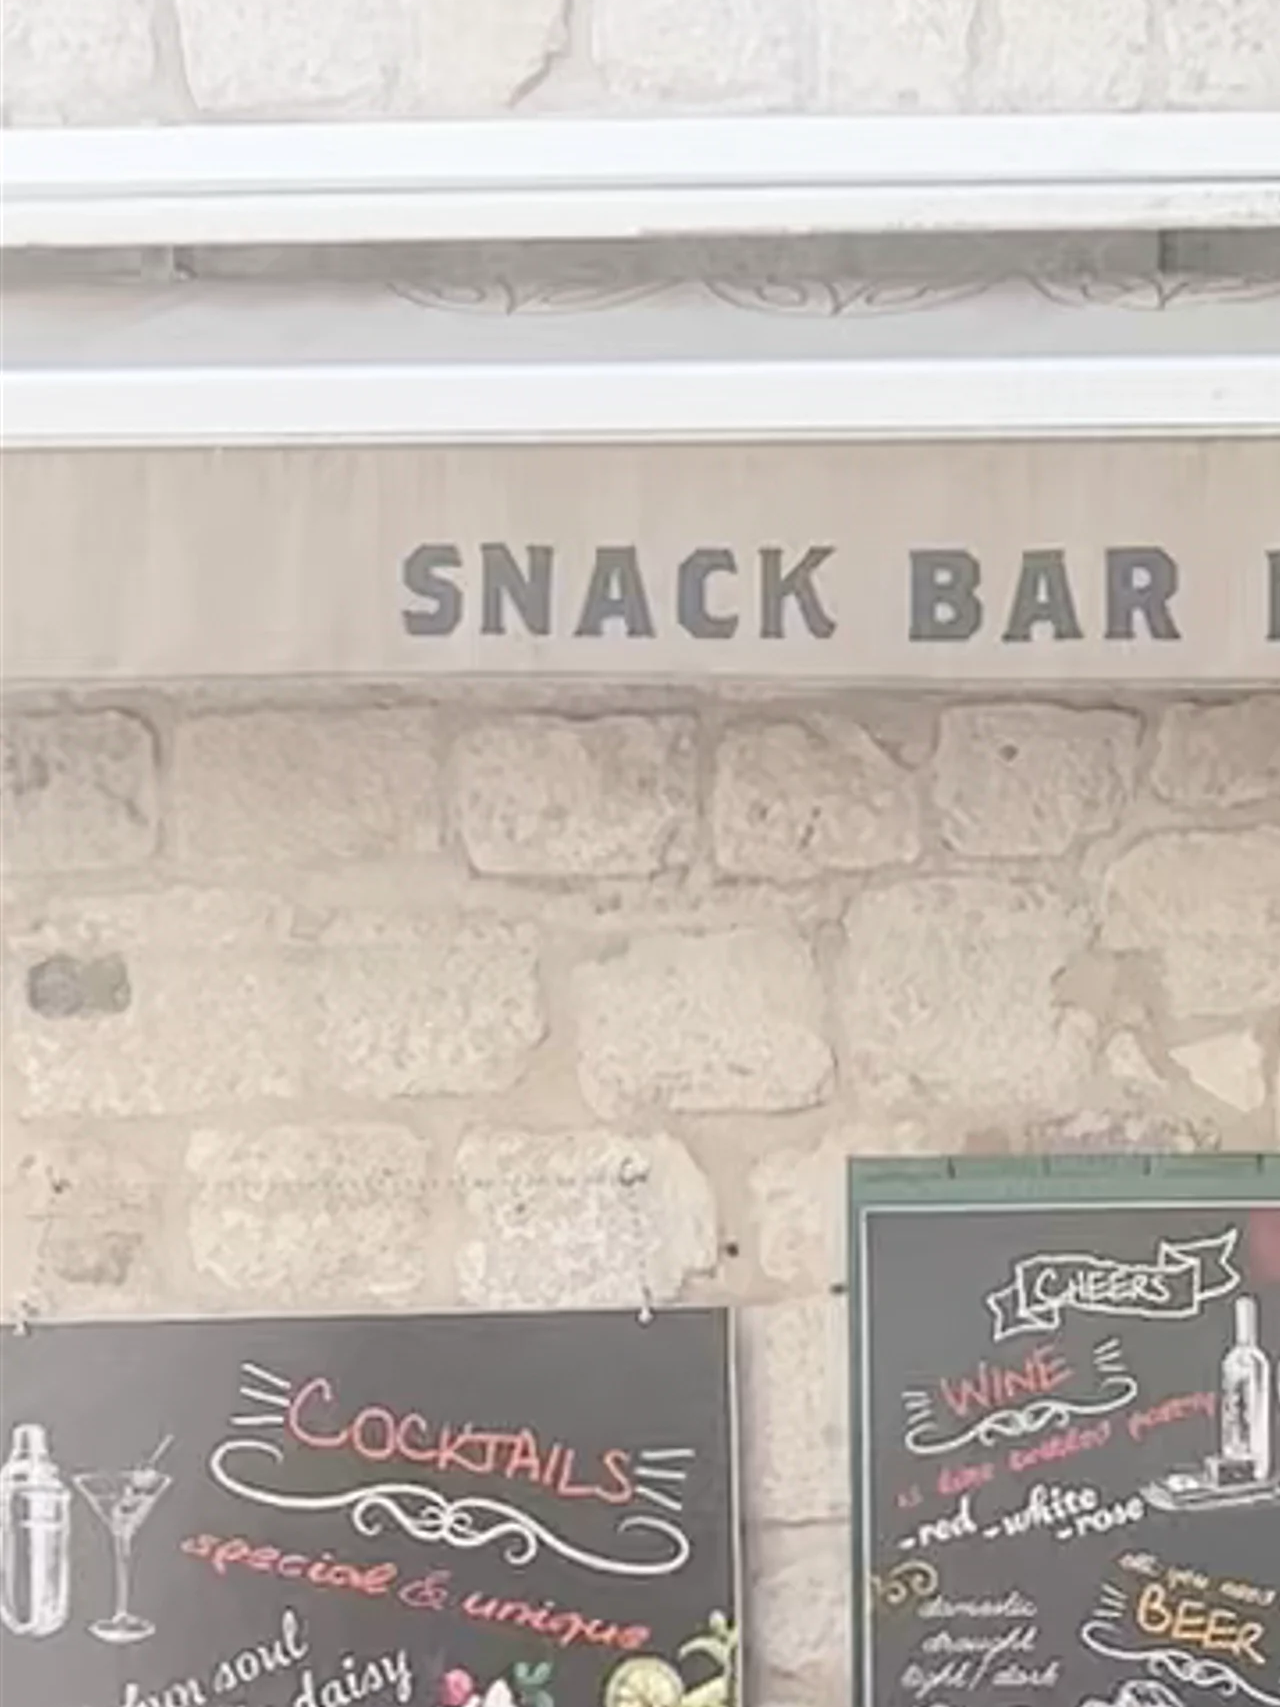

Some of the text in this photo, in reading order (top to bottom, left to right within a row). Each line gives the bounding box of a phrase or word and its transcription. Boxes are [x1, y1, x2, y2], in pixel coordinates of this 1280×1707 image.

[401, 541, 838, 643] SNACK
[906, 545, 1186, 645] BAR
[1035, 1269, 1170, 1303] CHEERS
[940, 1344, 1074, 1416] WINE
[288, 1378, 637, 1504] COCKTAILS
[181, 1532, 396, 1593] special
[462, 1592, 652, 1651] unique
[1136, 1583, 1265, 1665] BEER
[213, 1610, 309, 1692] soul
